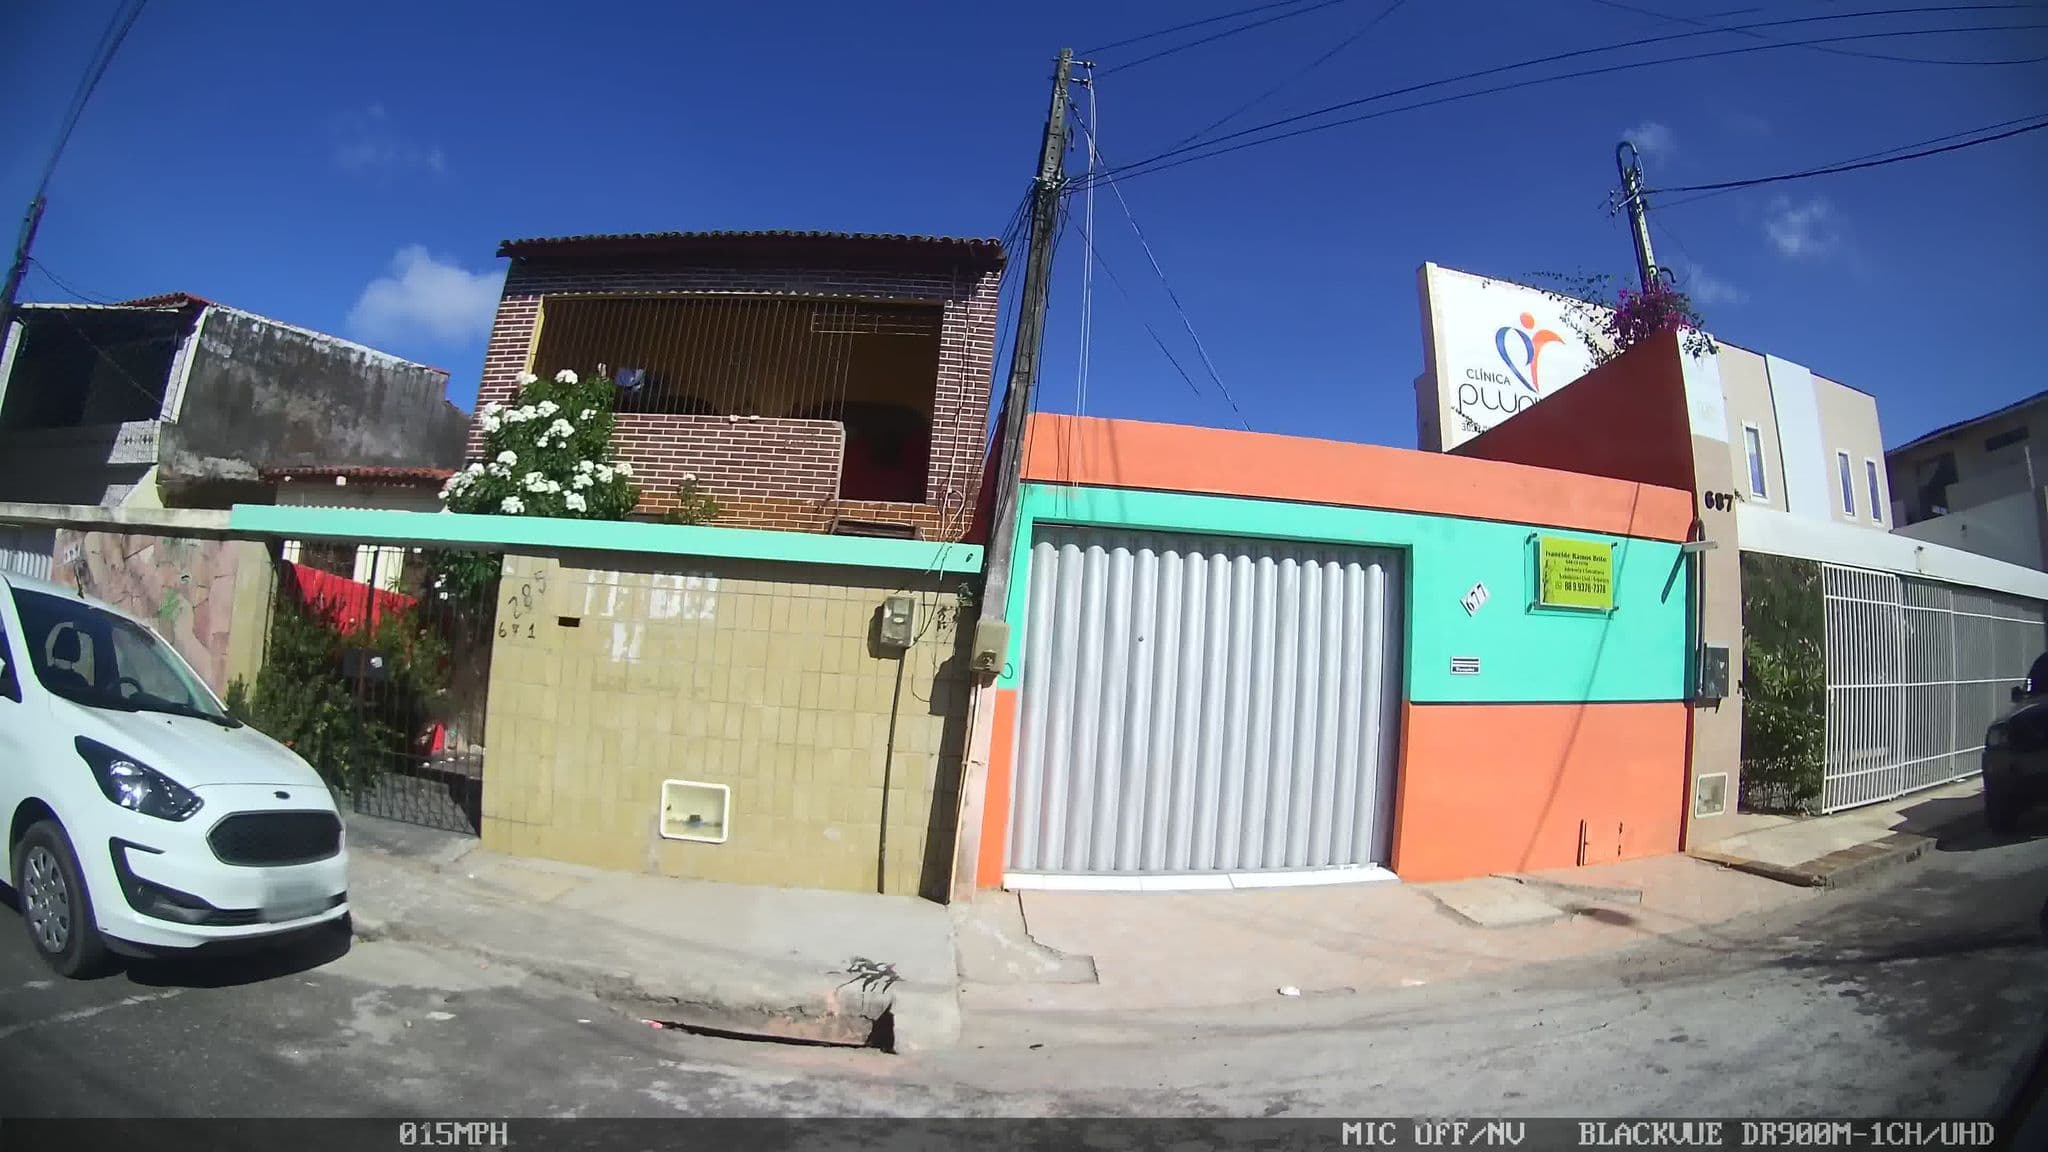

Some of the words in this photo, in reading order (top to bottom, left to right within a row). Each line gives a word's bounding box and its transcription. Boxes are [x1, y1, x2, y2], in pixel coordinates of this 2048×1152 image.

[1466, 368, 1511, 386] CLÍNICA
[1465, 583, 1486, 613] 677
[498, 621, 536, 639] 671
